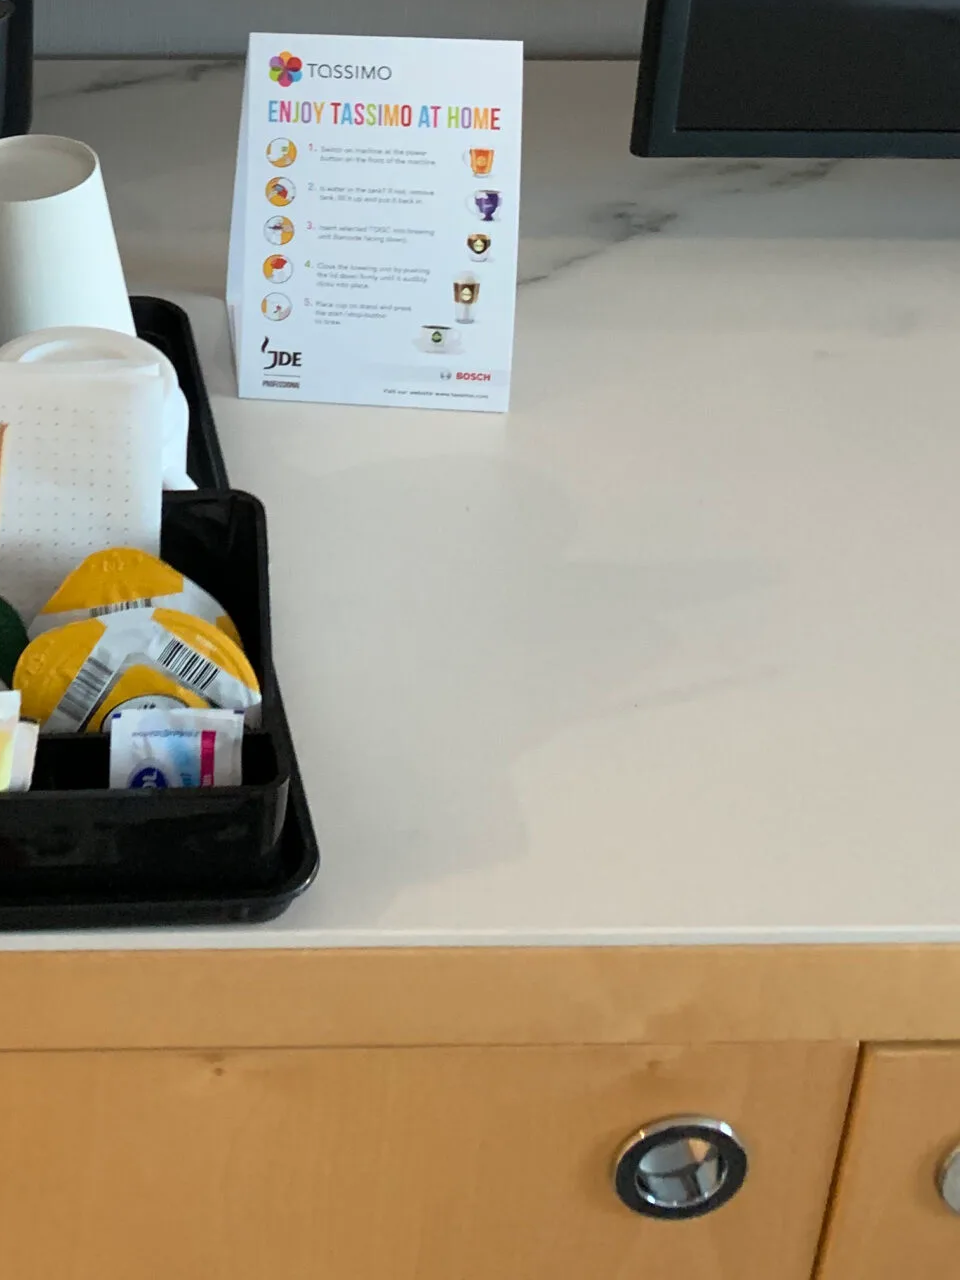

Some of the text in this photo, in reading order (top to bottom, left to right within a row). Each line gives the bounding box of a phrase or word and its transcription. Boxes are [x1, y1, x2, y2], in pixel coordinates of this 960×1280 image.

[306, 63, 392, 80] TASSIMO
[268, 100, 501, 130] ENJOY TASSIMO AT HOME
[263, 350, 302, 370] JDE
[456, 371, 491, 381] BOSCH
